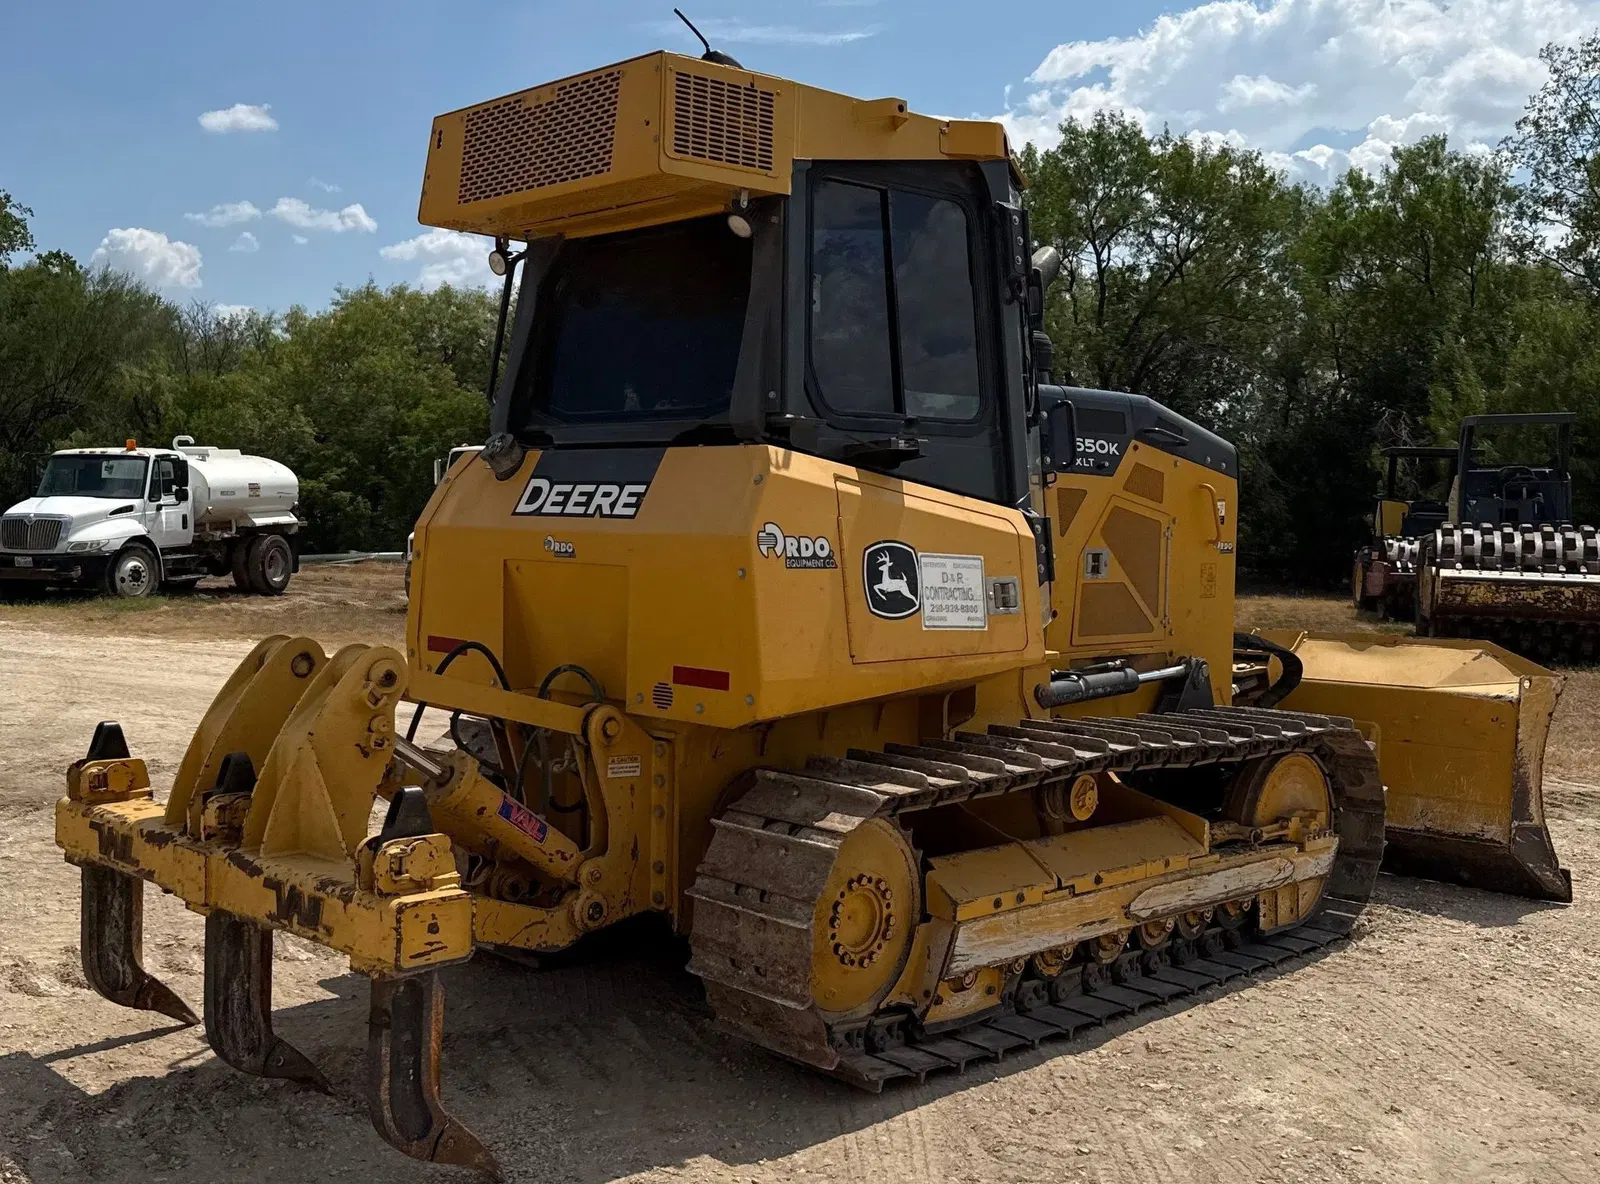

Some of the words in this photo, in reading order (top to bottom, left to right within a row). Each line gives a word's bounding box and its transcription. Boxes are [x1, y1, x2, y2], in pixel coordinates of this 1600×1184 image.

[1075, 437, 1120, 456] 650K
[1075, 457, 1096, 468] XLT
[514, 478, 646, 516] DEERE
[786, 558, 824, 568] EQUIPMENT
[924, 586, 974, 602] CONTRACTING
